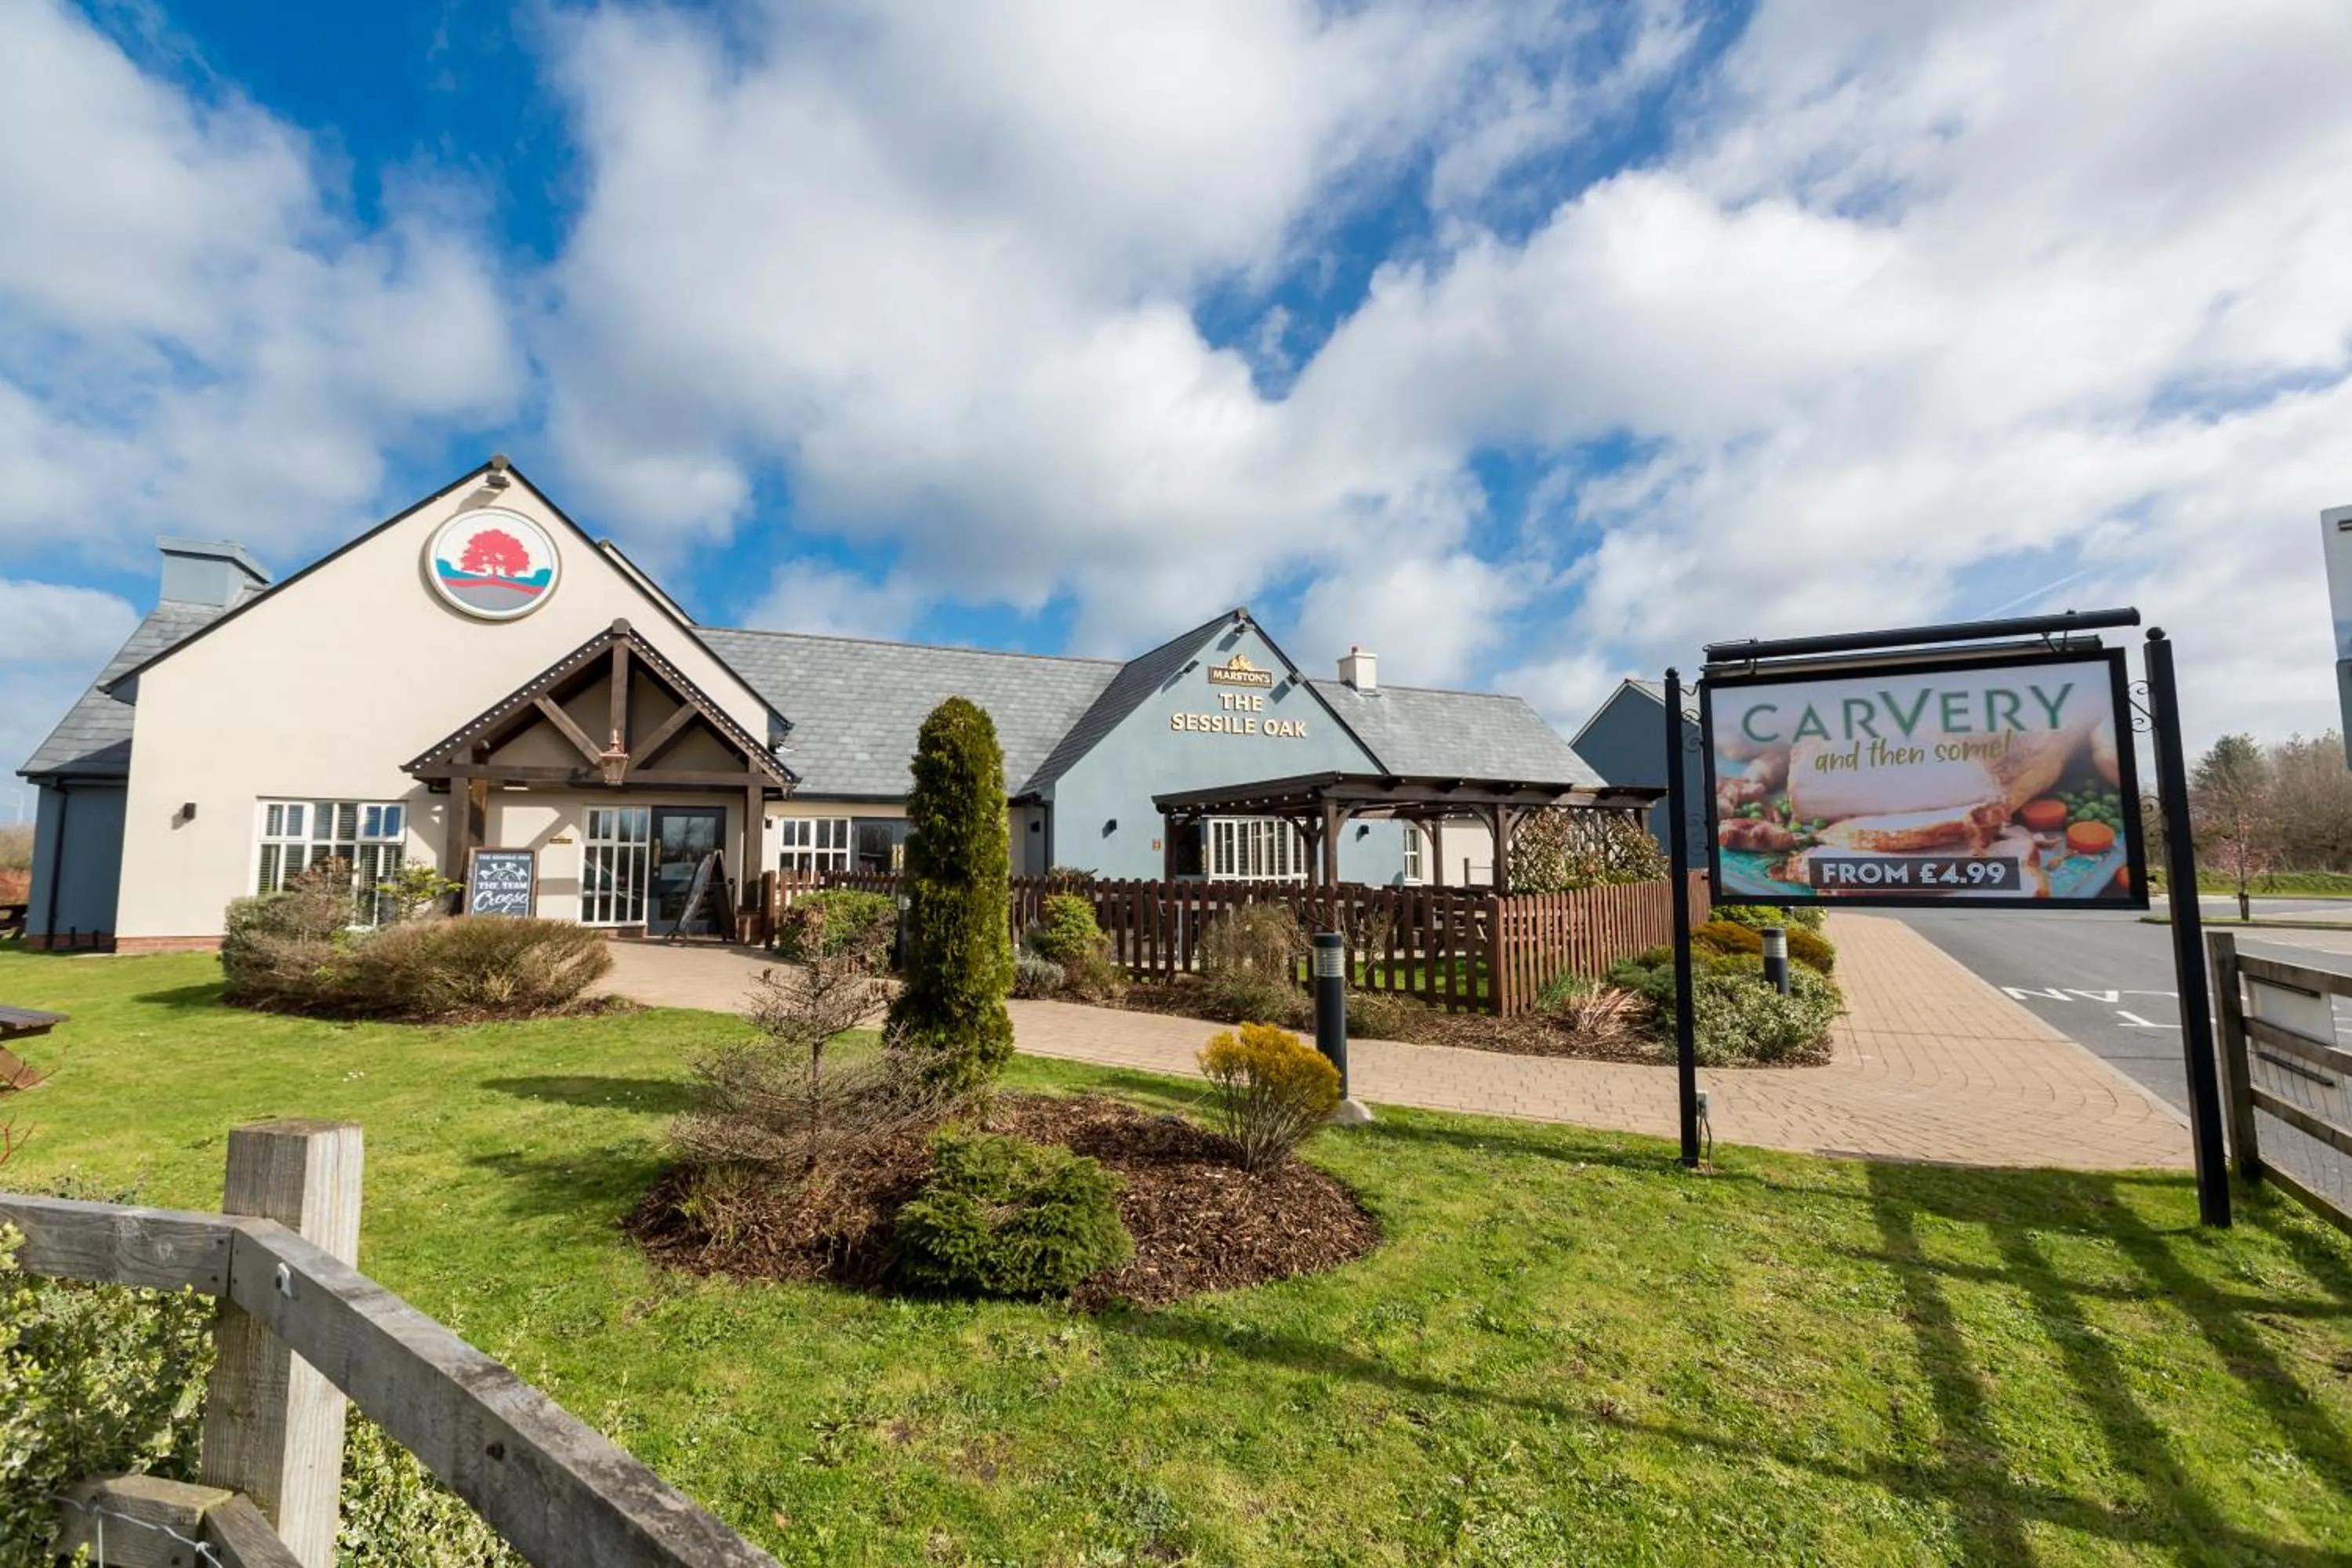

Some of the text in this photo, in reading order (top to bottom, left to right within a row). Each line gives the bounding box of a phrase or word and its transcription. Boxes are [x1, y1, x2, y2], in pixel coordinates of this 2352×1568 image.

[1219, 692, 1264, 712] THE
[1741, 682, 2074, 742] CARVERY
[1171, 712, 1308, 738] SESSILE OAK
[1814, 728, 2013, 773] and then some!
[1822, 862, 2006, 884] FROM £4.99
